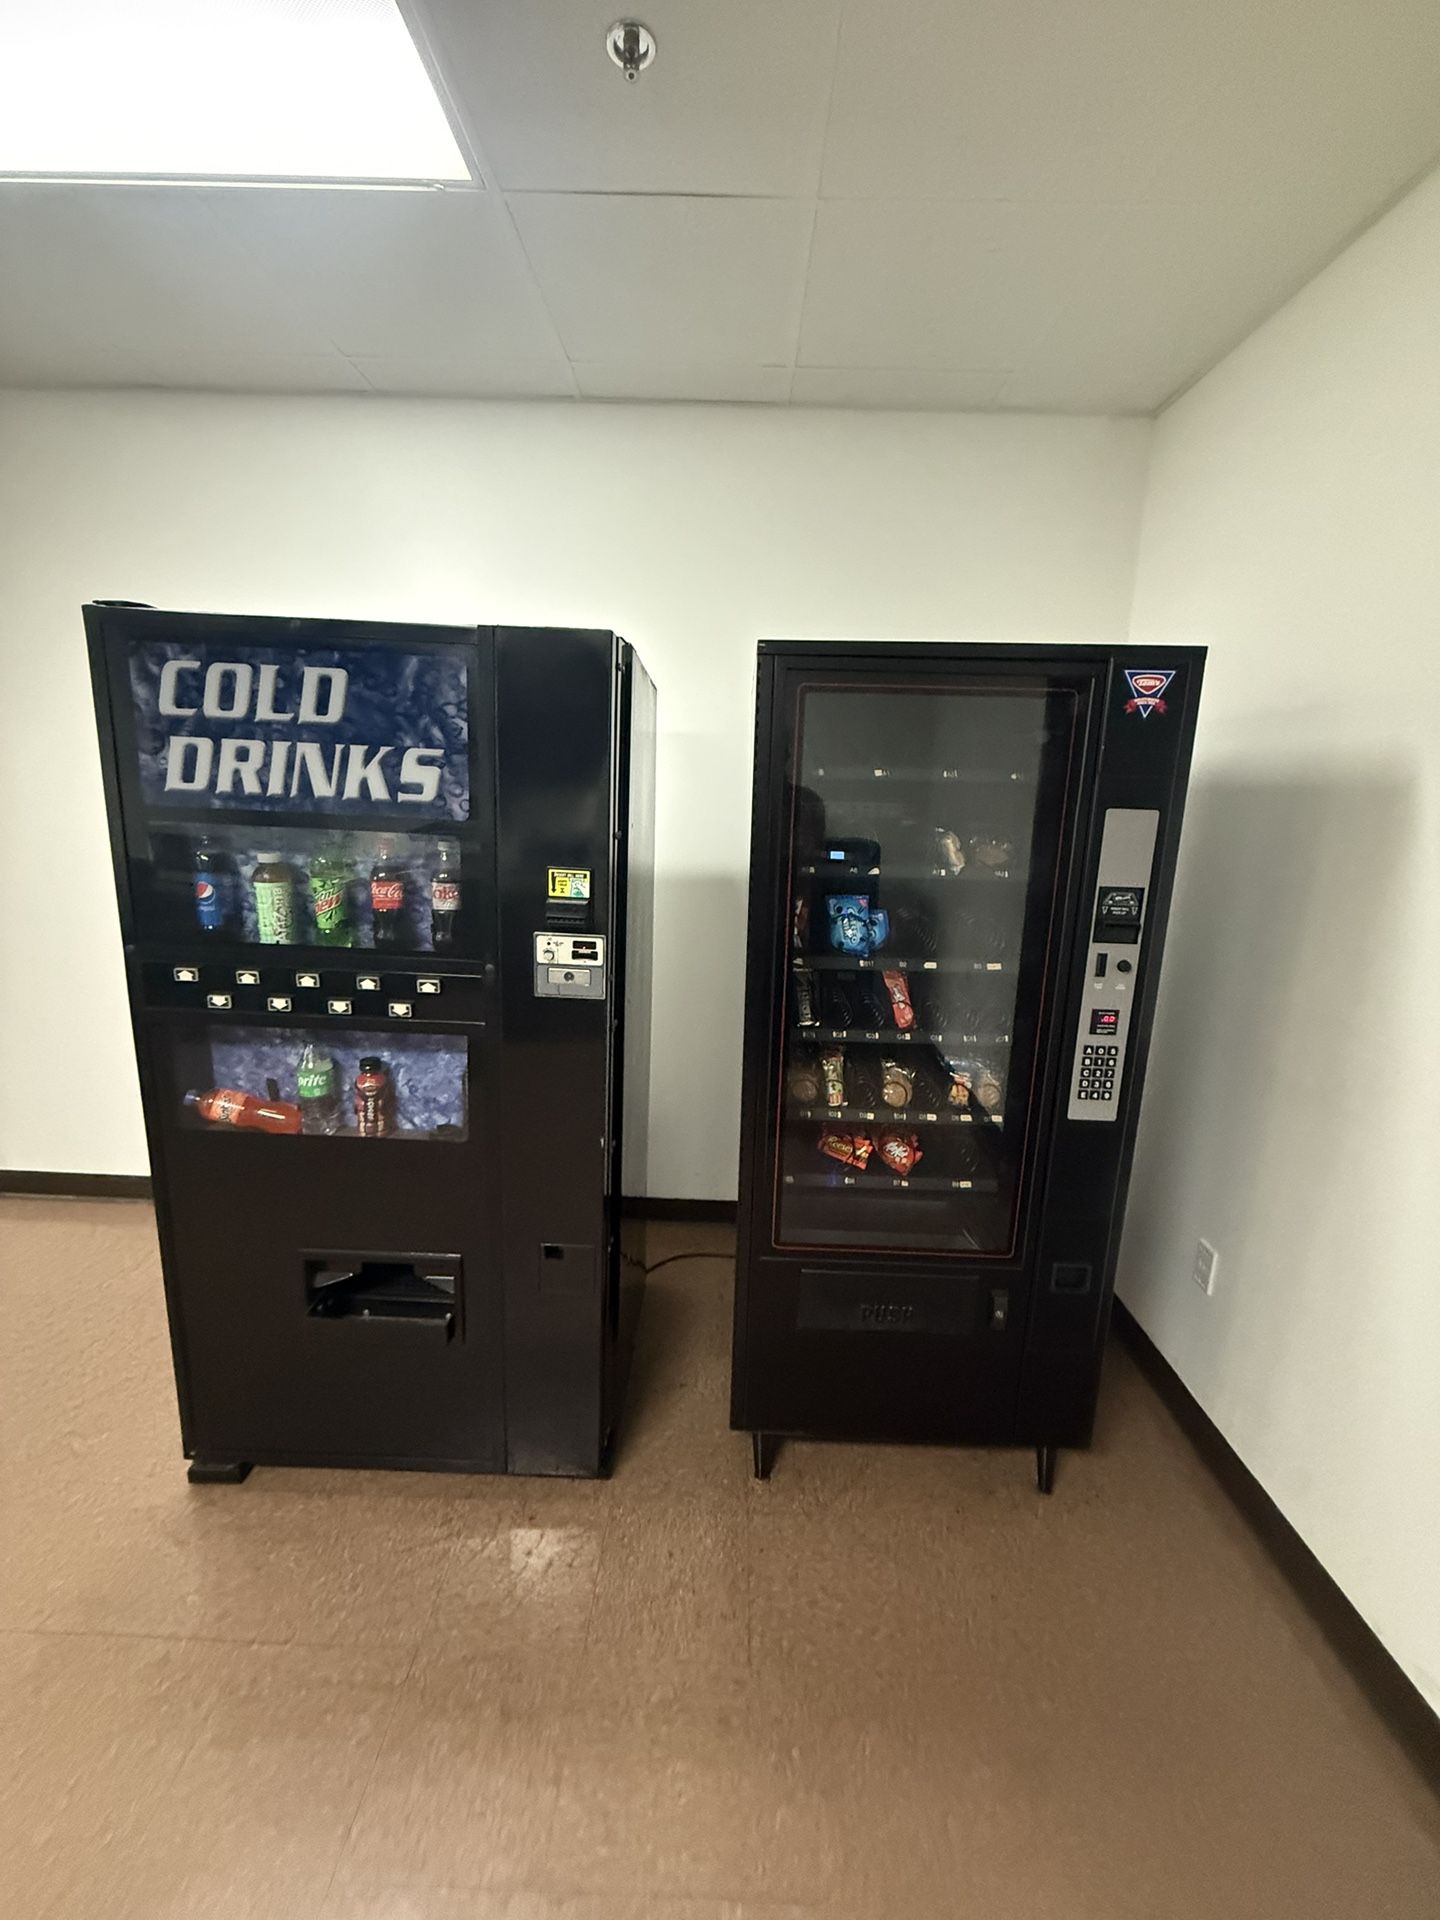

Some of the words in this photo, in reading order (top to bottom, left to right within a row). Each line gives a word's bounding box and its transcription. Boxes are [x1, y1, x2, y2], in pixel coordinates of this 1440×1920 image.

[158, 660, 349, 725] COLD
[164, 735, 445, 804] DRINKS
[297, 1073, 327, 1088] prite
